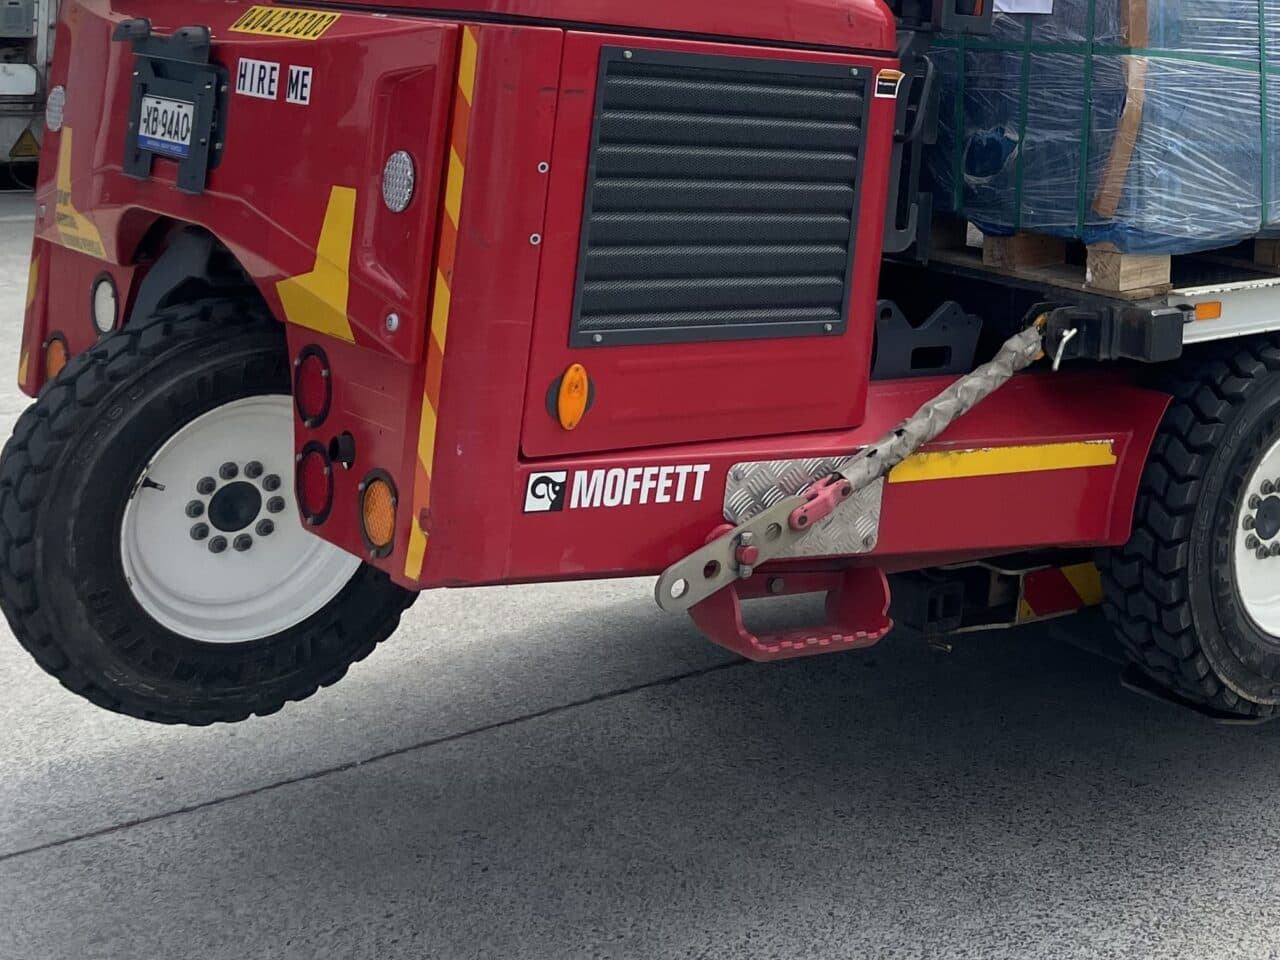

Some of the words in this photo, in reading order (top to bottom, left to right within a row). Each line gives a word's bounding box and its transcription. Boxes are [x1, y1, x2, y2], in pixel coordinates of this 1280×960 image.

[238, 61, 277, 96] HIRE
[287, 68, 310, 101] ME
[569, 464, 710, 509] MOFFETT
